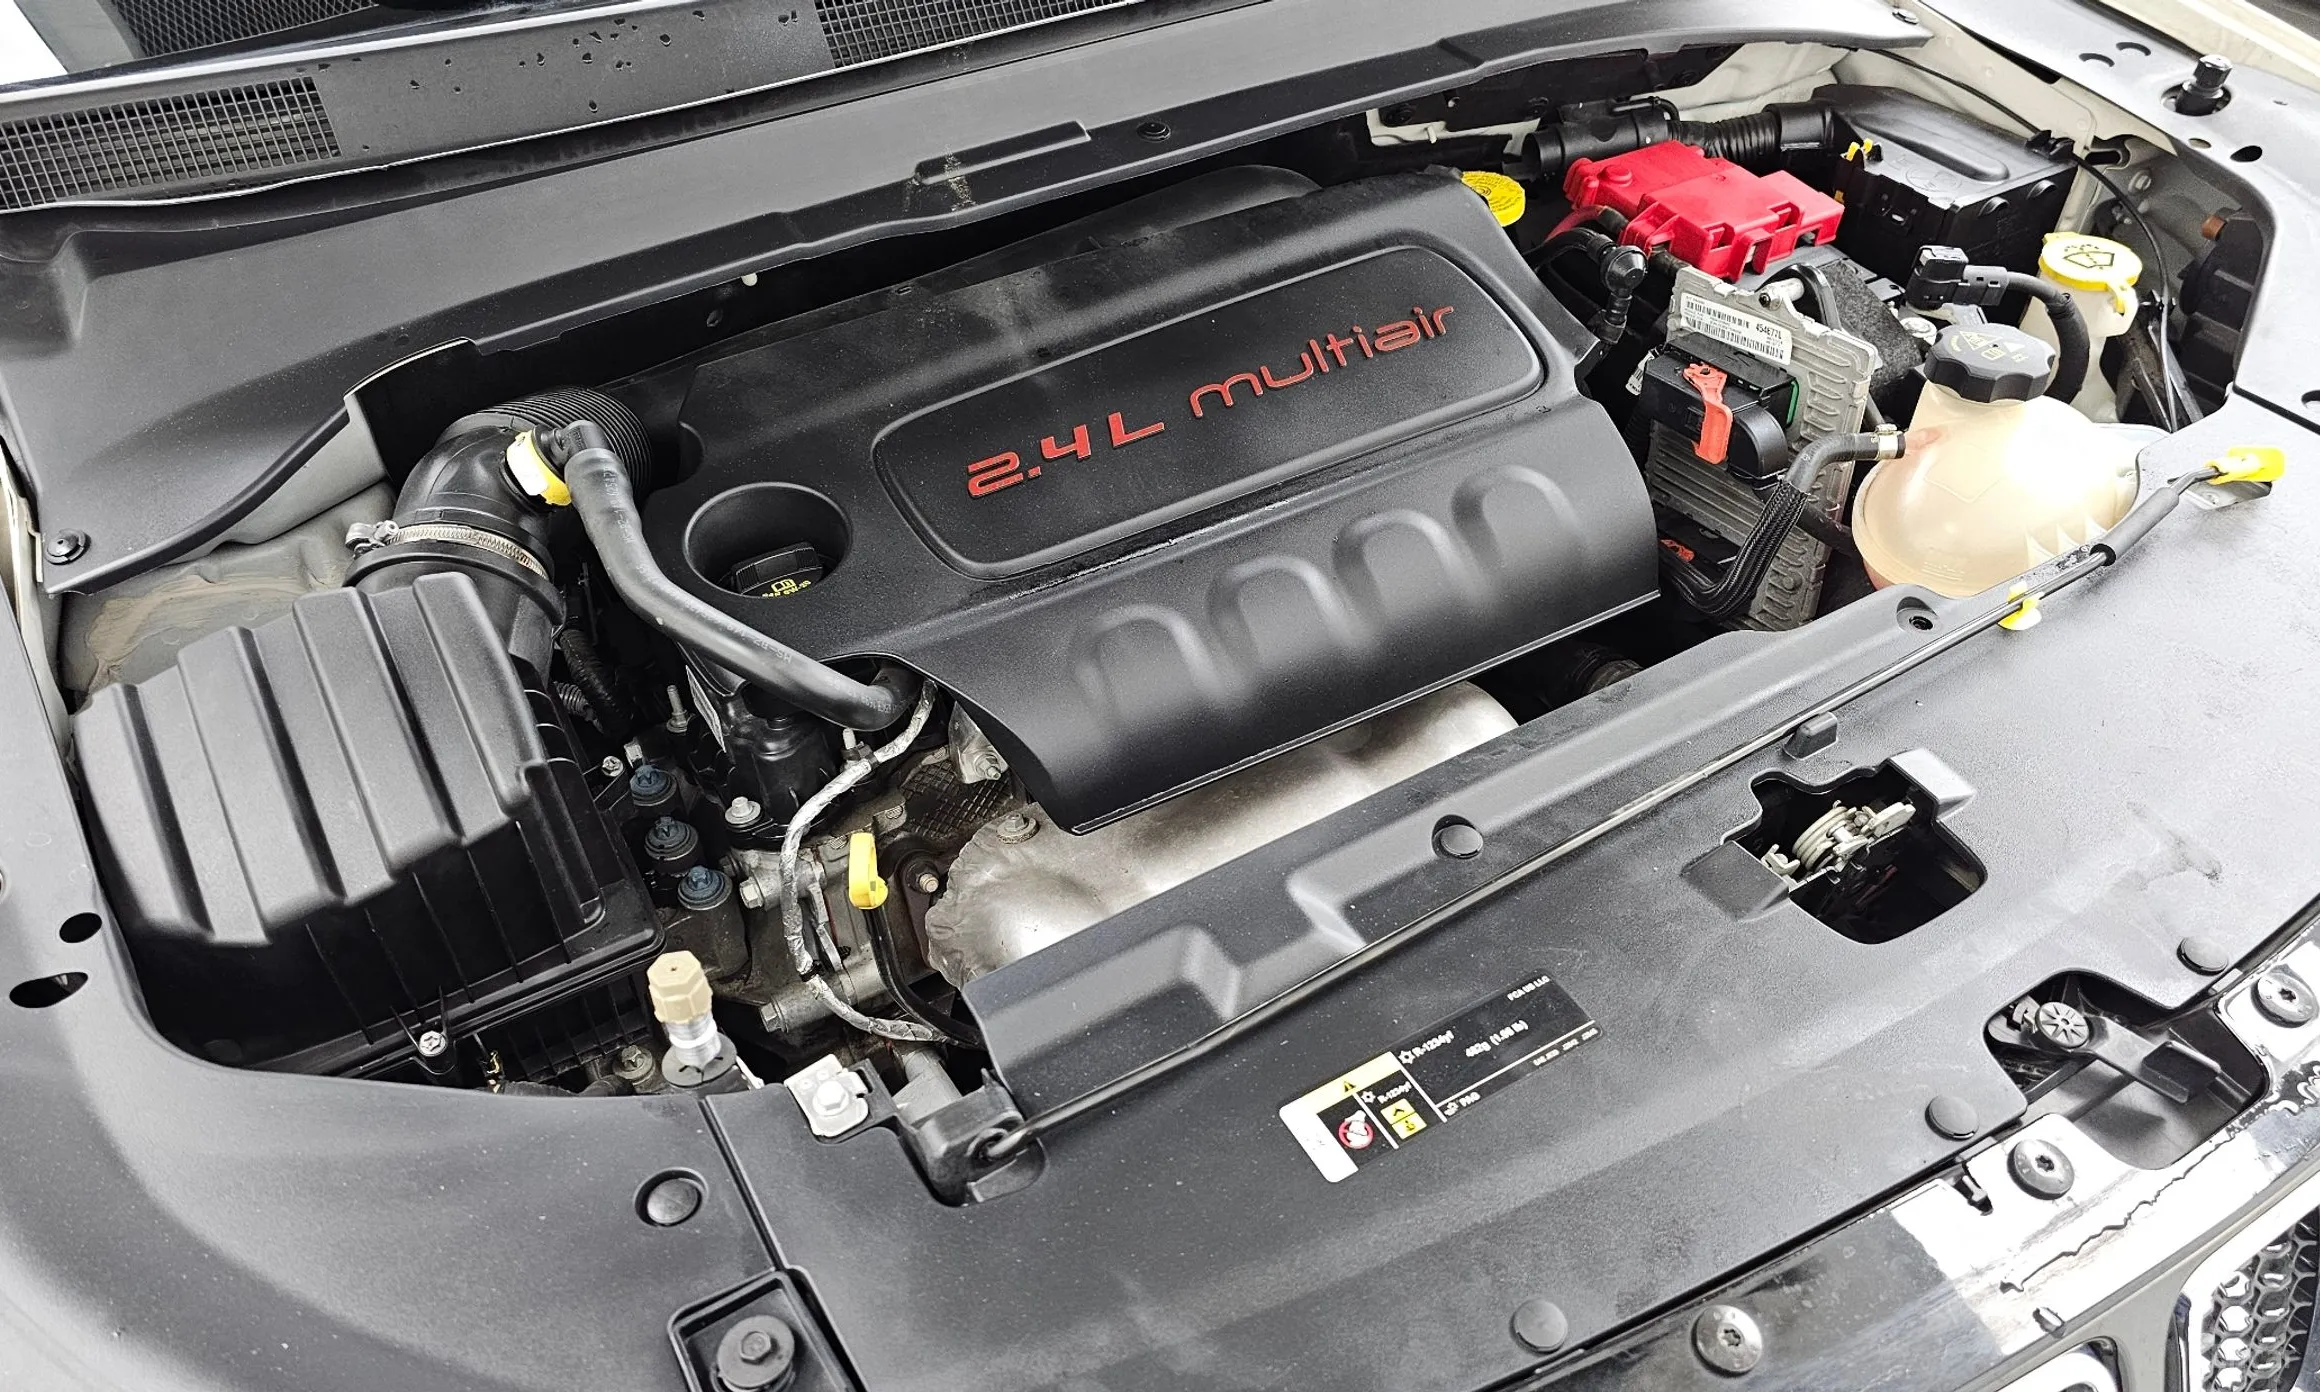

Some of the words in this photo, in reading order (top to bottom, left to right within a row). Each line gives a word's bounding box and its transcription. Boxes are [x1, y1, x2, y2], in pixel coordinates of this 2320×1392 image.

[967, 424, 1091, 498] 2.4
[1107, 412, 1164, 447] L
[1187, 305, 1455, 418] multiair
[1458, 1091, 1481, 1108] PAG
